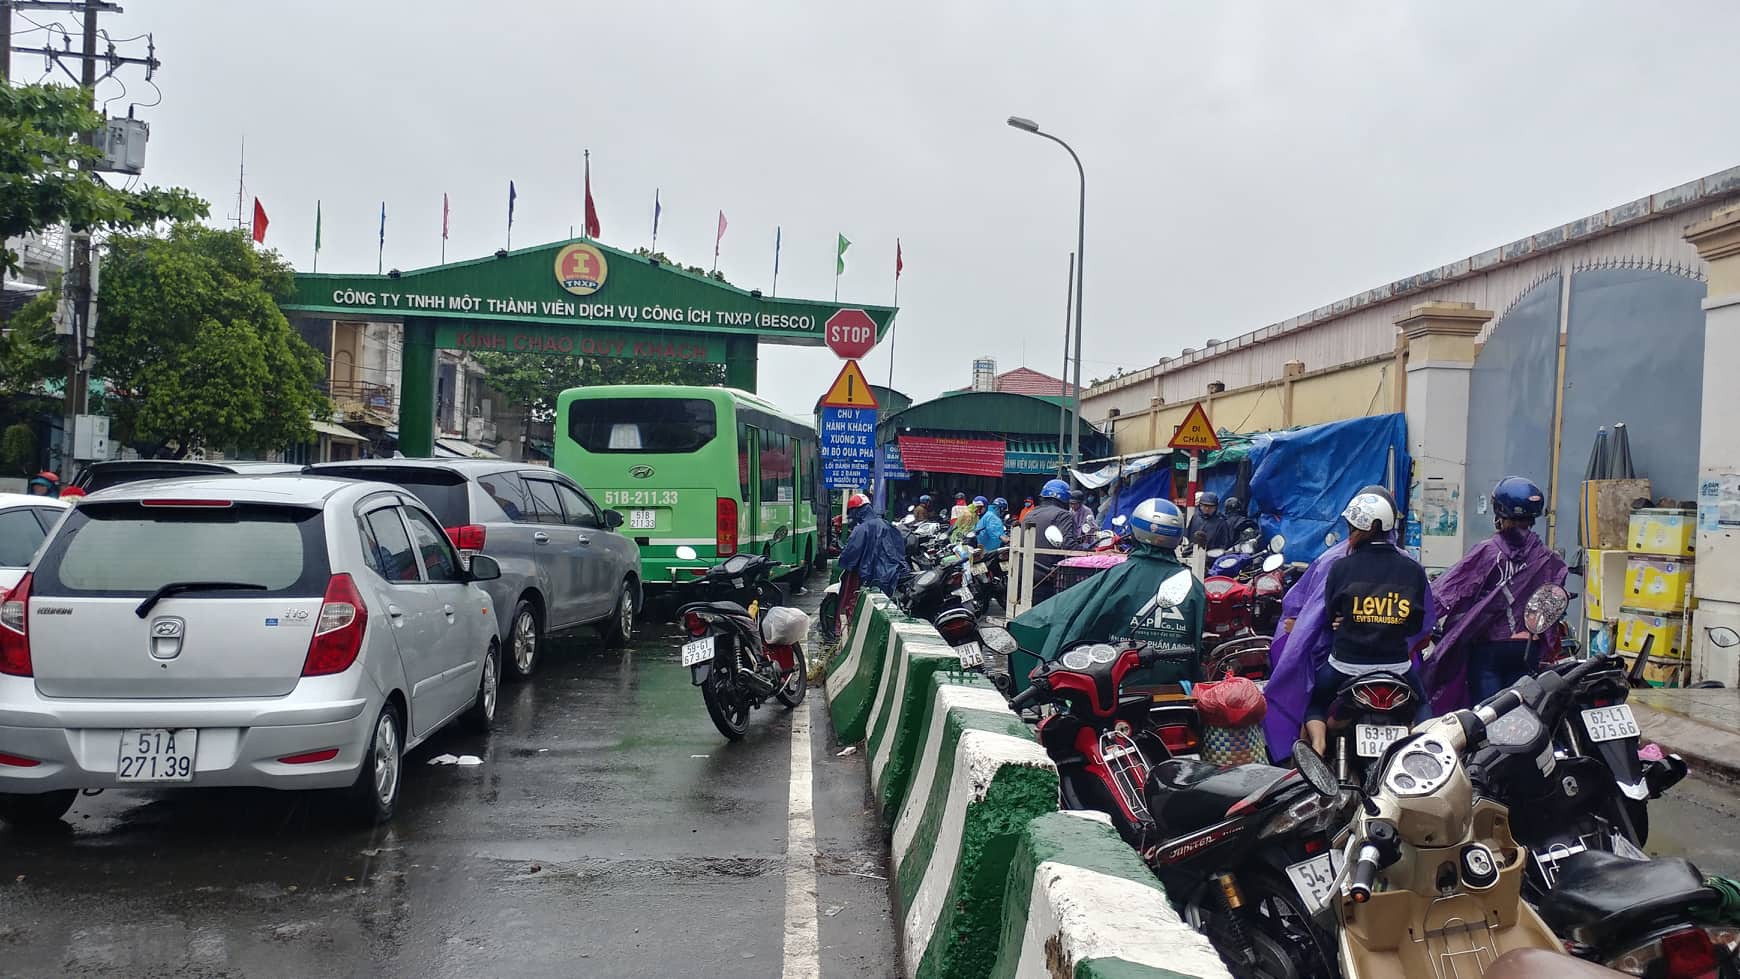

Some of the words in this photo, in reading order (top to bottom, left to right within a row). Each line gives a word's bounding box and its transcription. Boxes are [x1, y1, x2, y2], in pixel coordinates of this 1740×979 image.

[332, 288, 377, 306] CÔNG
[380, 293, 400, 307] TY
[406, 294, 445, 309] TNHH
[449, 295, 482, 313] MỘT
[487, 297, 537, 315] THÀNH
[542, 299, 575, 316] VIÊN
[579, 303, 614, 321] DỊCH
[618, 305, 637, 323] VỤ
[642, 304, 683, 322] CÔNG
[687, 305, 711, 323] ÍCH
[716, 311, 751, 325] TNXP
[754, 313, 816, 330] (BESCO)
[831, 326, 871, 343] STOP
[857, 435, 867, 445] XE
[831, 445, 841, 459] BỘ
[842, 447, 857, 457] QUA
[604, 491, 678, 505] 51B-211.33
[636, 511, 650, 520] 51B
[1352, 591, 1410, 618] Levi's
[1130, 616, 1154, 627] AP
[1590, 721, 1636, 740] 375.66
[138, 732, 176, 755] 51A
[120, 755, 191, 778] 271.39
[1297, 863, 1330, 888] 54-
